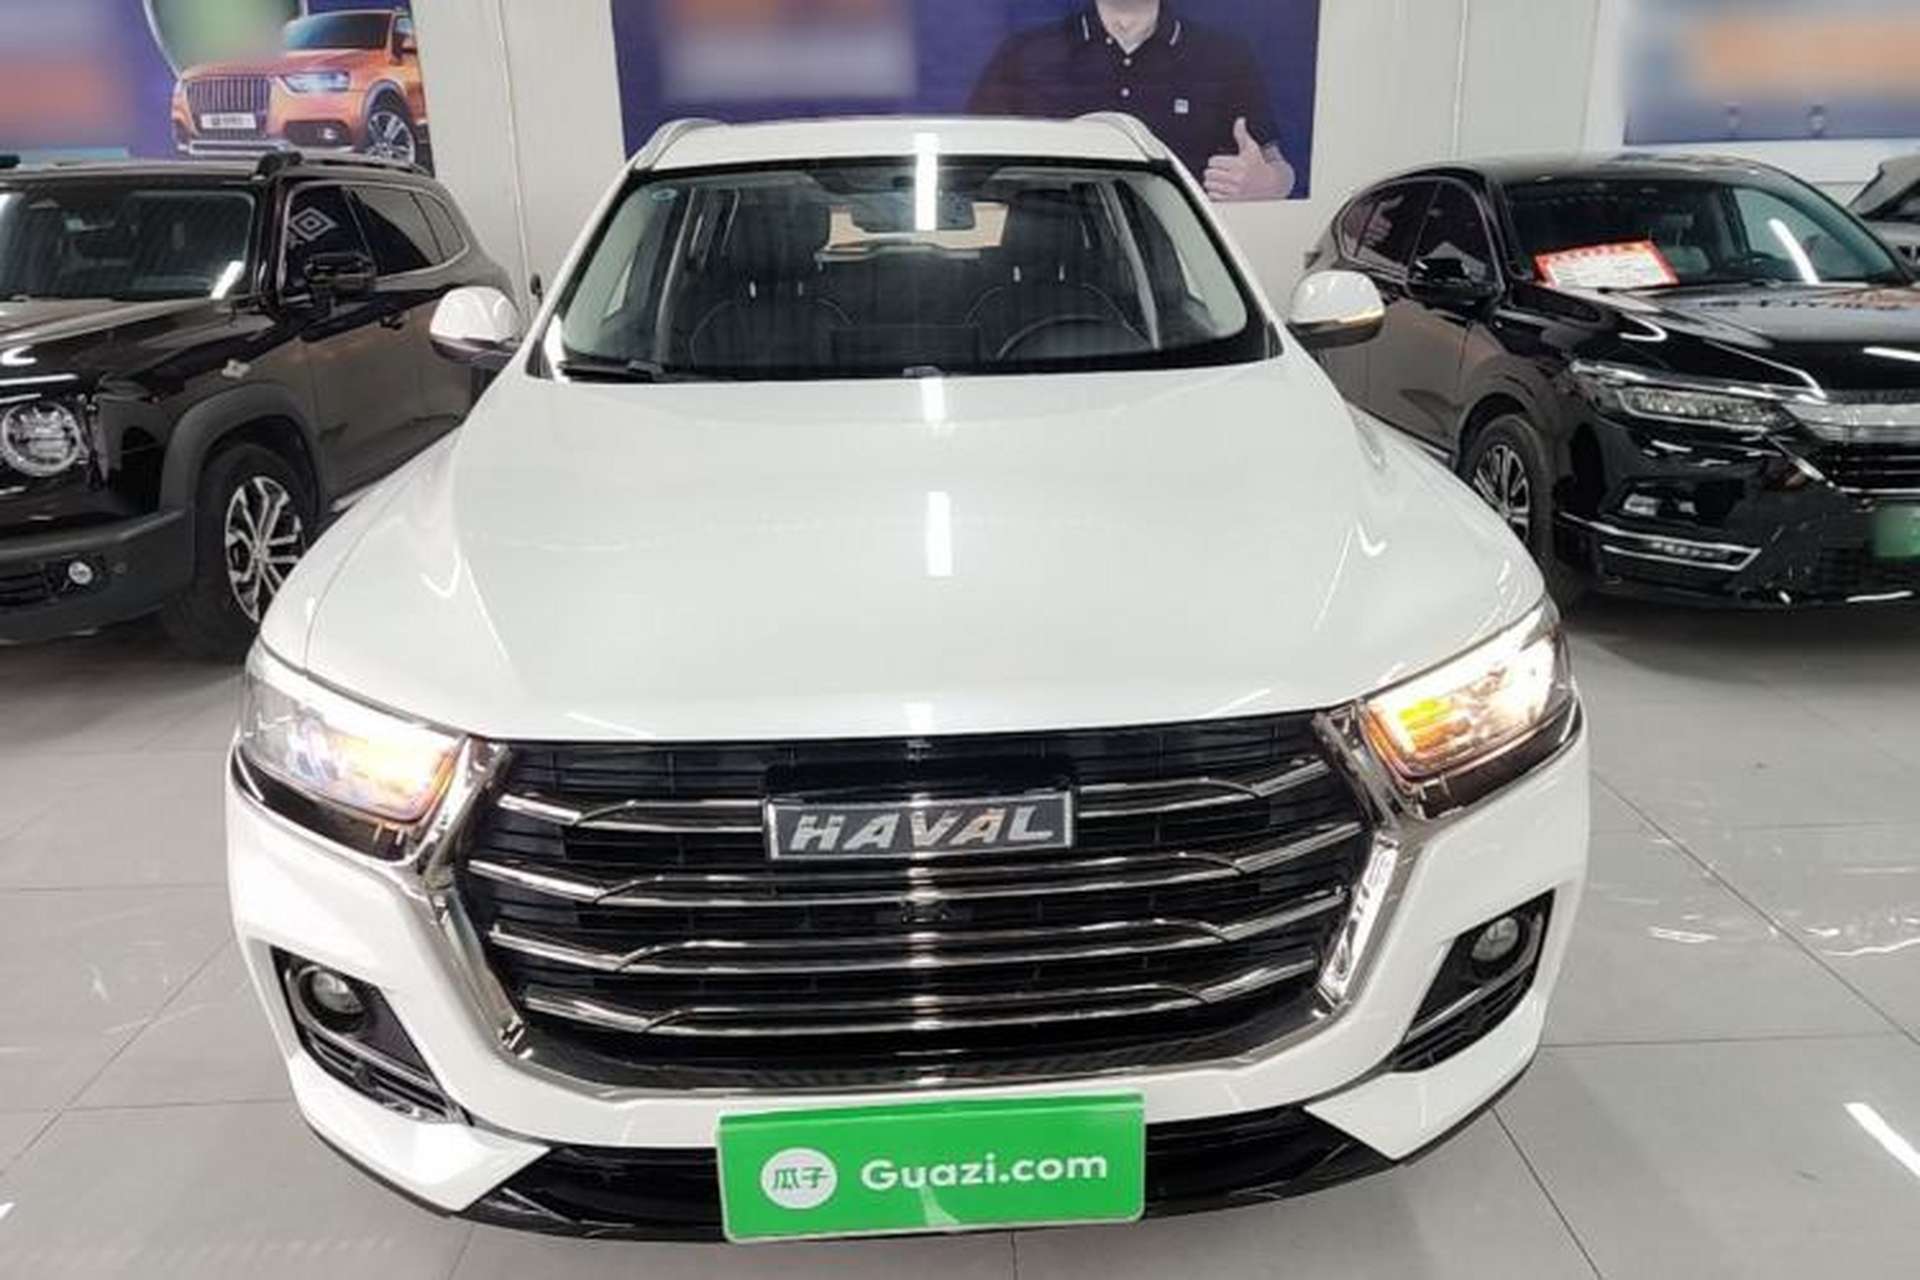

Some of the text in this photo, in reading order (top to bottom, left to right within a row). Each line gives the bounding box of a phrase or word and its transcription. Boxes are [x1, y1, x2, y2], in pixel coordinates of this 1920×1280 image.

[789, 805, 1054, 851] HAVAL
[773, 1165, 830, 1191] 瓜子
[861, 1153, 1108, 1191] Guazi.com
